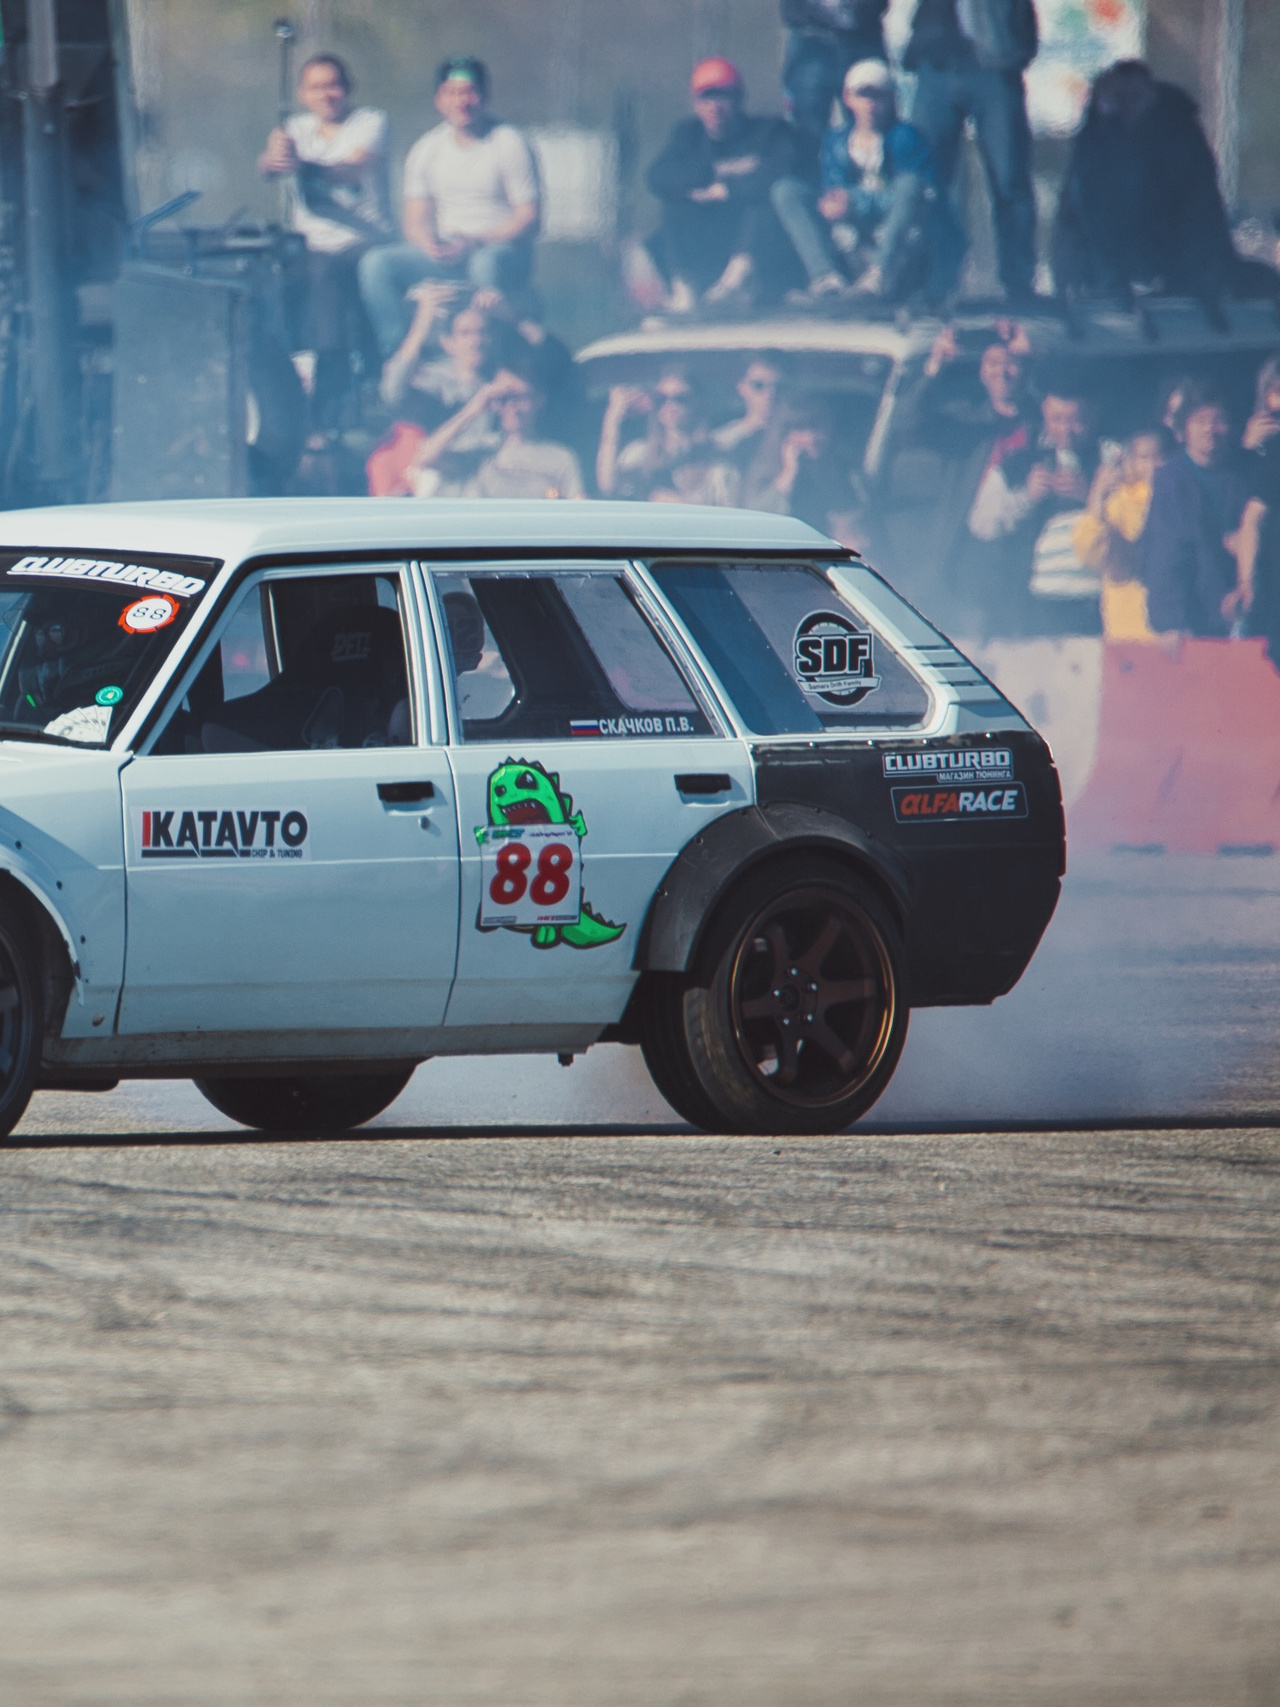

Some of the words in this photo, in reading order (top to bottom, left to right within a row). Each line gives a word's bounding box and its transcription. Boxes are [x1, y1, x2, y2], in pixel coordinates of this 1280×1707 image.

[10, 556, 206, 595] CLUBTURBO
[797, 634, 870, 676] SDF
[600, 718, 663, 735] СКАЧКОВ
[665, 716, 695, 732] П.В.
[885, 751, 1011, 771] CLUBTURBO
[939, 771, 975, 781] МАГАЗИН
[975, 770, 1011, 779] ТЮНИНГА
[489, 842, 573, 906] 88
